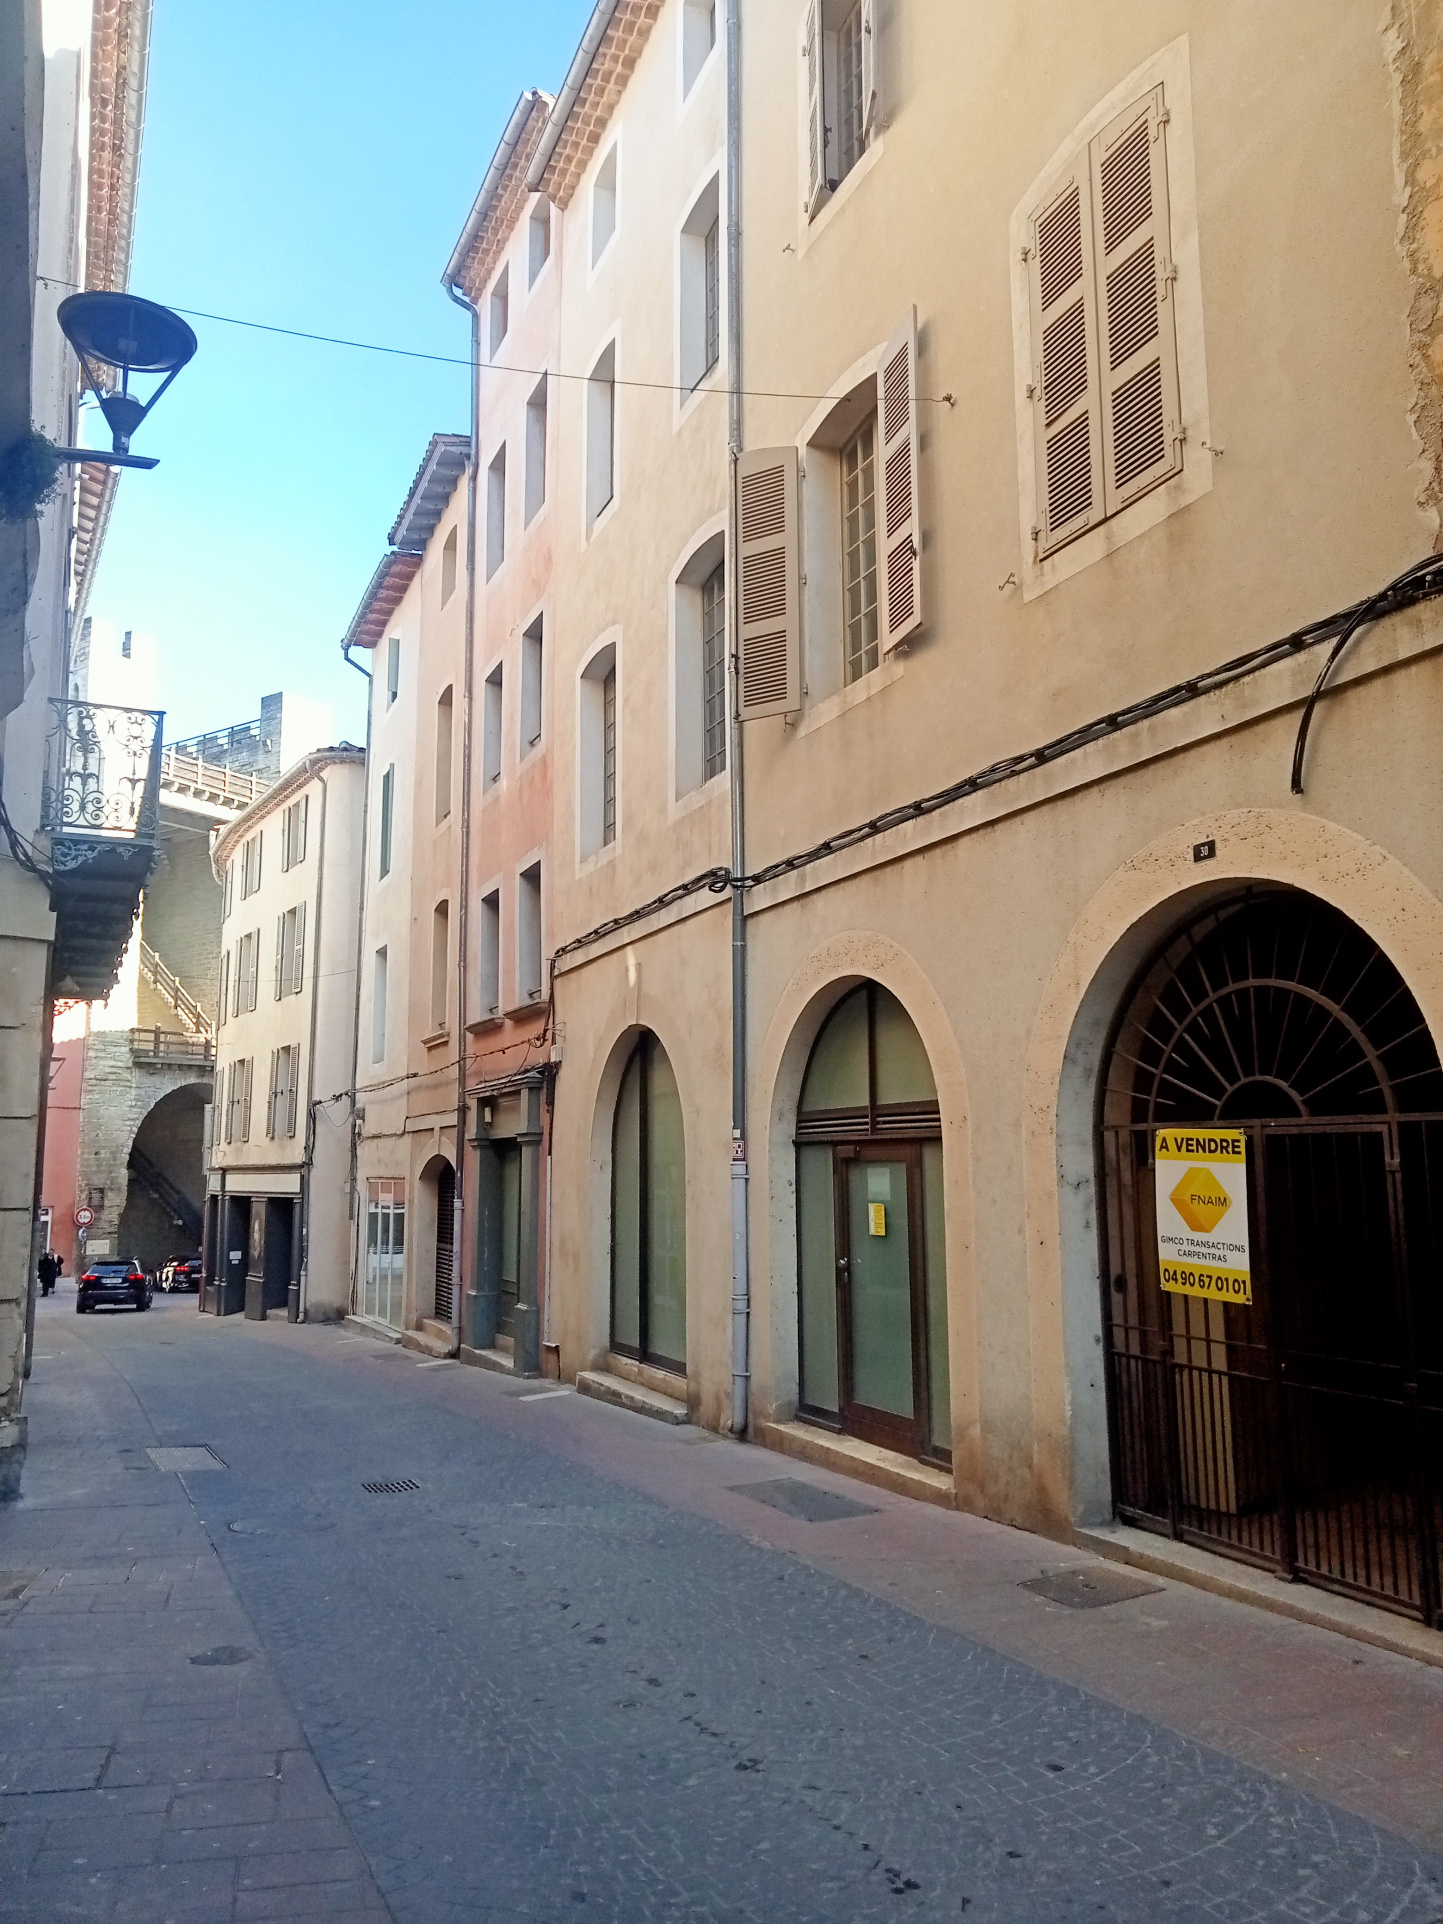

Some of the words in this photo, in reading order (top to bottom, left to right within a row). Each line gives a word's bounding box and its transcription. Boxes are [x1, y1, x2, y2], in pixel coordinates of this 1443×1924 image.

[1200, 846, 1208, 857] 30
[1159, 1136, 1170, 1152] A
[1174, 1137, 1242, 1155] VENDRE
[1190, 1194, 1228, 1208] FNAIM
[1160, 1235, 1184, 1246] GIMCO
[1186, 1238, 1246, 1253] TRANSACTIONS
[1177, 1248, 1228, 1263] CARPENTRAS
[1163, 1267, 1179, 1285] 04
[1180, 1270, 1196, 1287] 90
[1198, 1273, 1213, 1290] 67
[1215, 1276, 1230, 1293] 01
[1232, 1278, 1247, 1295] 01
